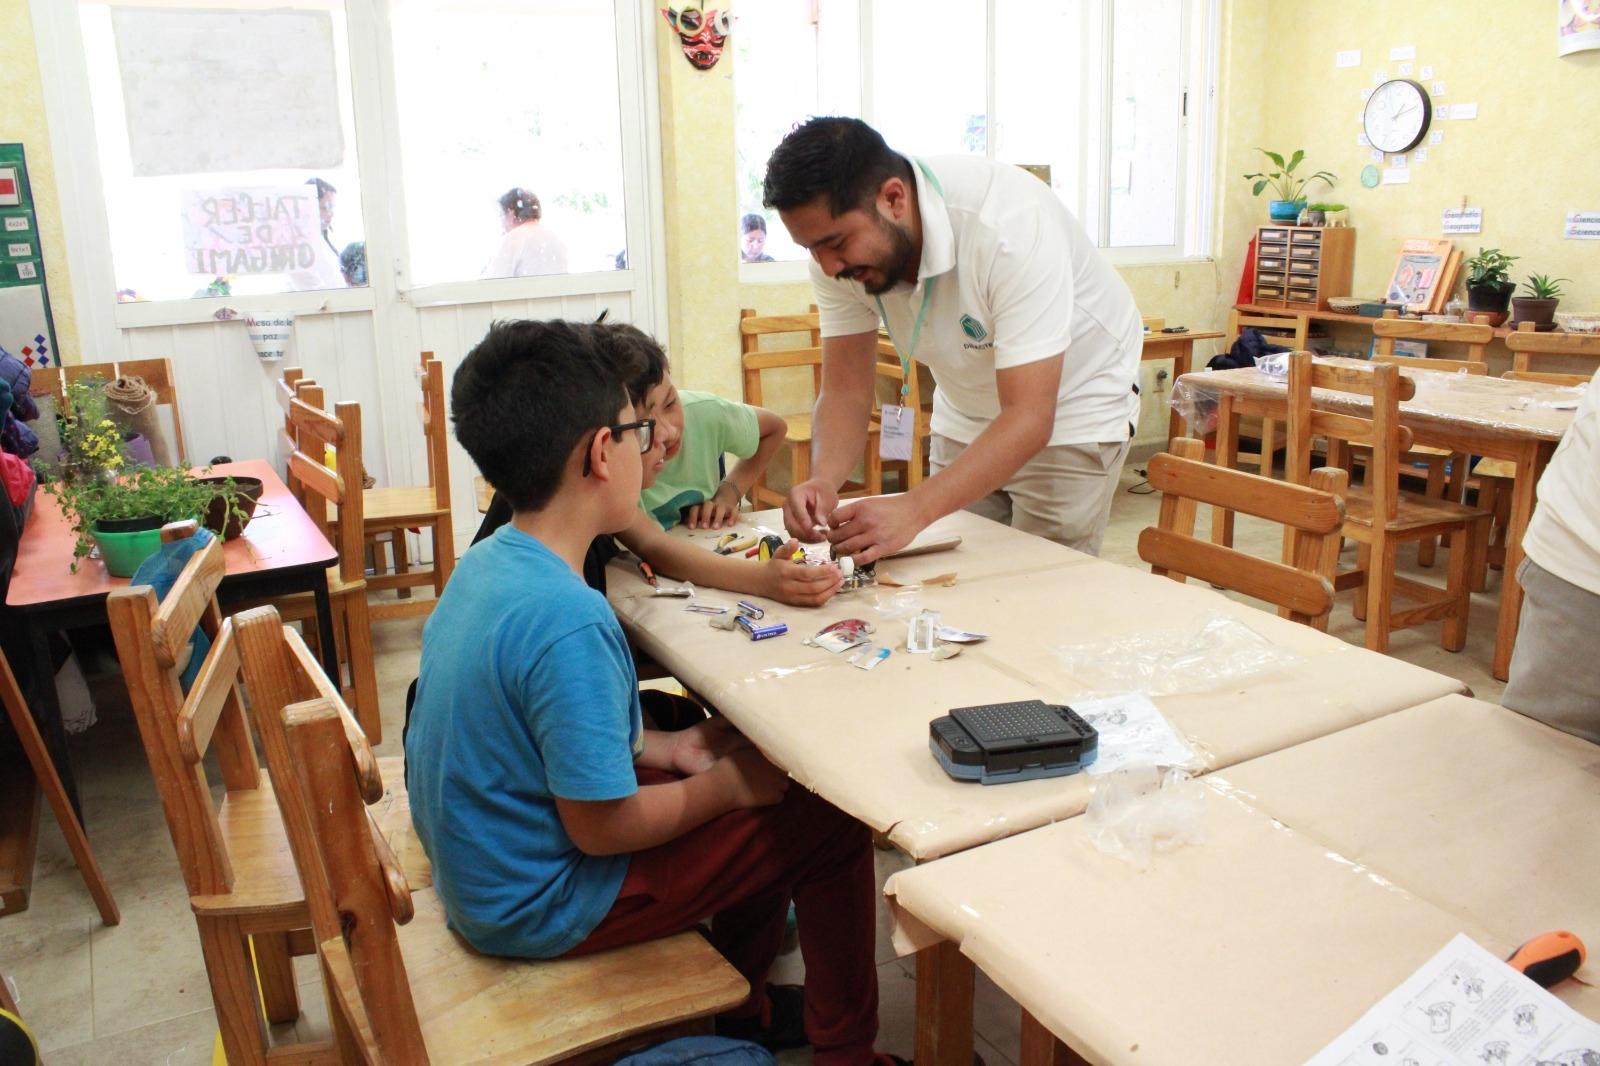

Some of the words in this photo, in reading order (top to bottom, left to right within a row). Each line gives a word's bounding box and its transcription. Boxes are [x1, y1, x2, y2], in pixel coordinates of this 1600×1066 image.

[246, 317, 270, 327] Mesa
[273, 318, 285, 326] de
[263, 334, 278, 342] paz
